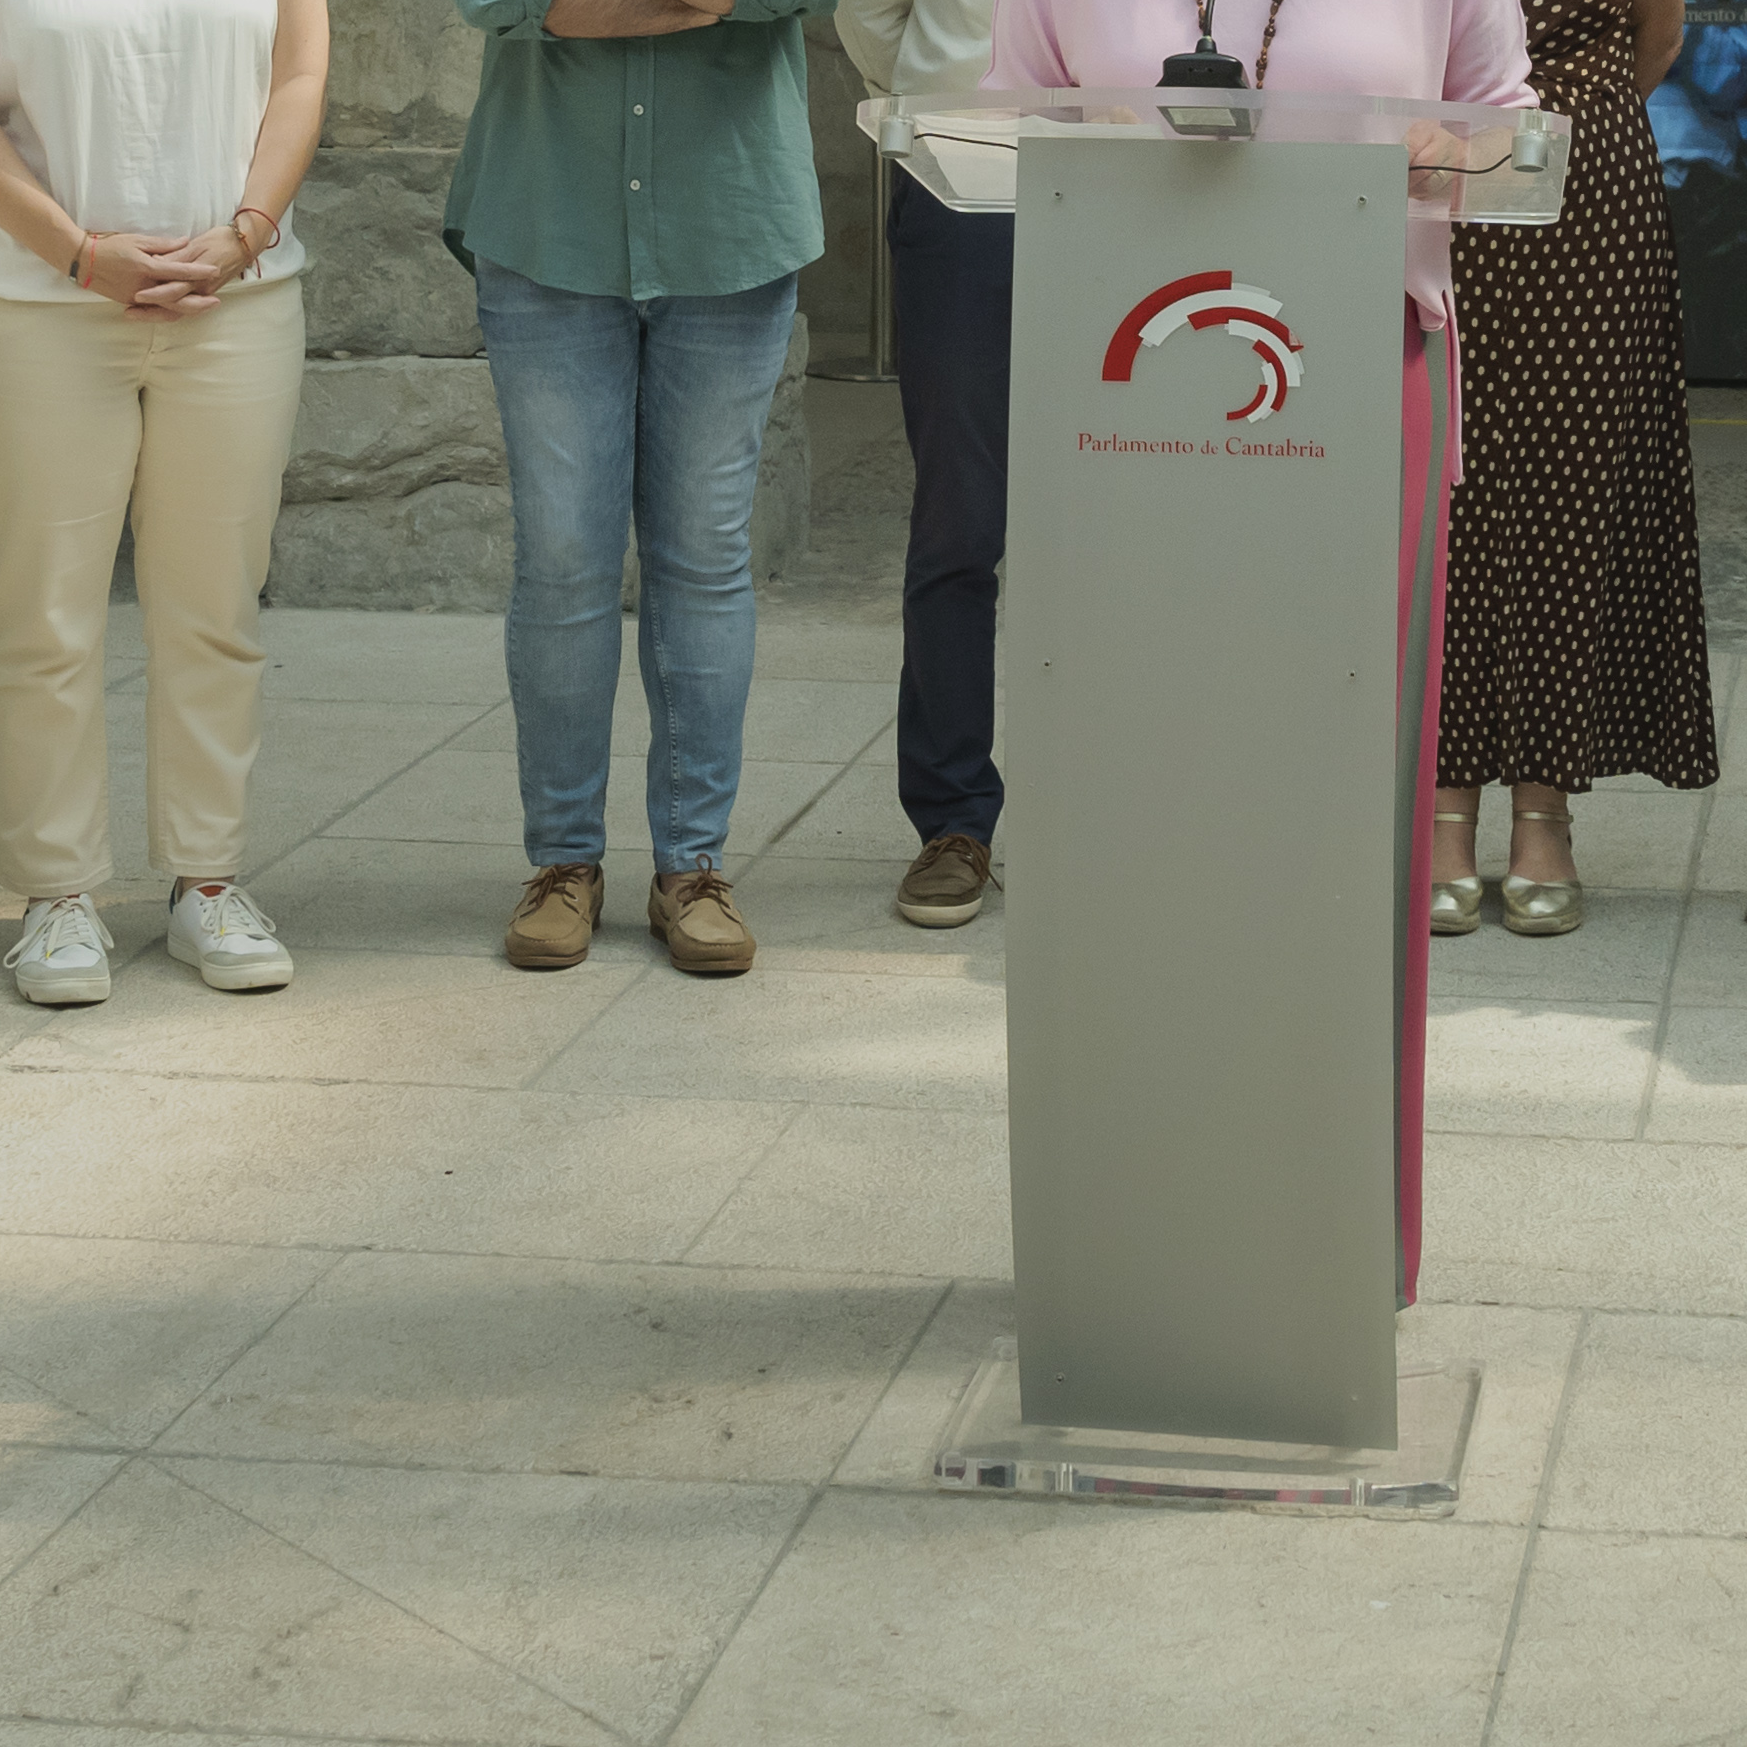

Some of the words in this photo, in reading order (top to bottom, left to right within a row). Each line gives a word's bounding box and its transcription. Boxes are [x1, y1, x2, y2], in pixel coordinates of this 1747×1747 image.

[1684, 8, 1736, 22] mento
[1077, 432, 1194, 454] Parlamento
[1200, 440, 1219, 455] de
[1225, 436, 1325, 458] Cantabria
